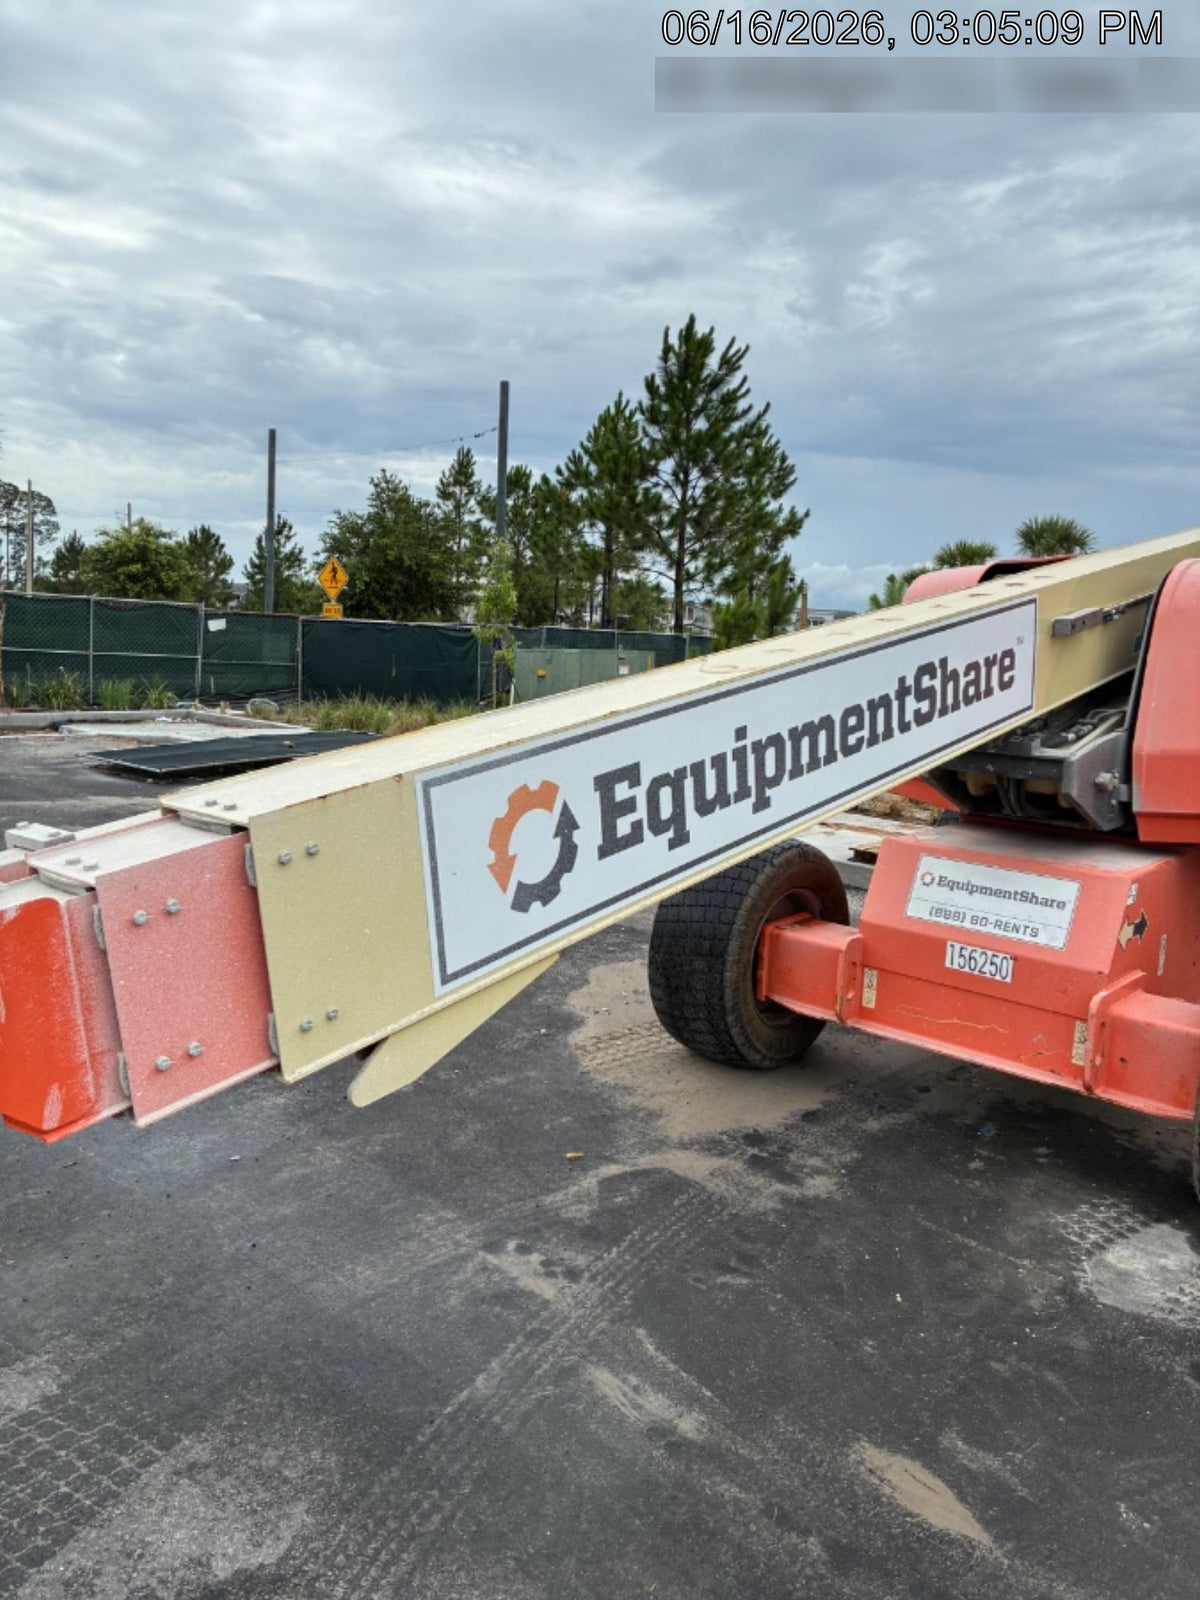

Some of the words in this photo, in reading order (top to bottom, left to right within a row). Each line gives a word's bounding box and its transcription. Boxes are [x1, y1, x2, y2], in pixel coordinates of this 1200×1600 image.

[594, 647, 1016, 861] EquipmentShare
[937, 875, 1066, 910] EquipmentShare
[929, 906, 966, 923] (888)
[949, 943, 1009, 980] 156250
